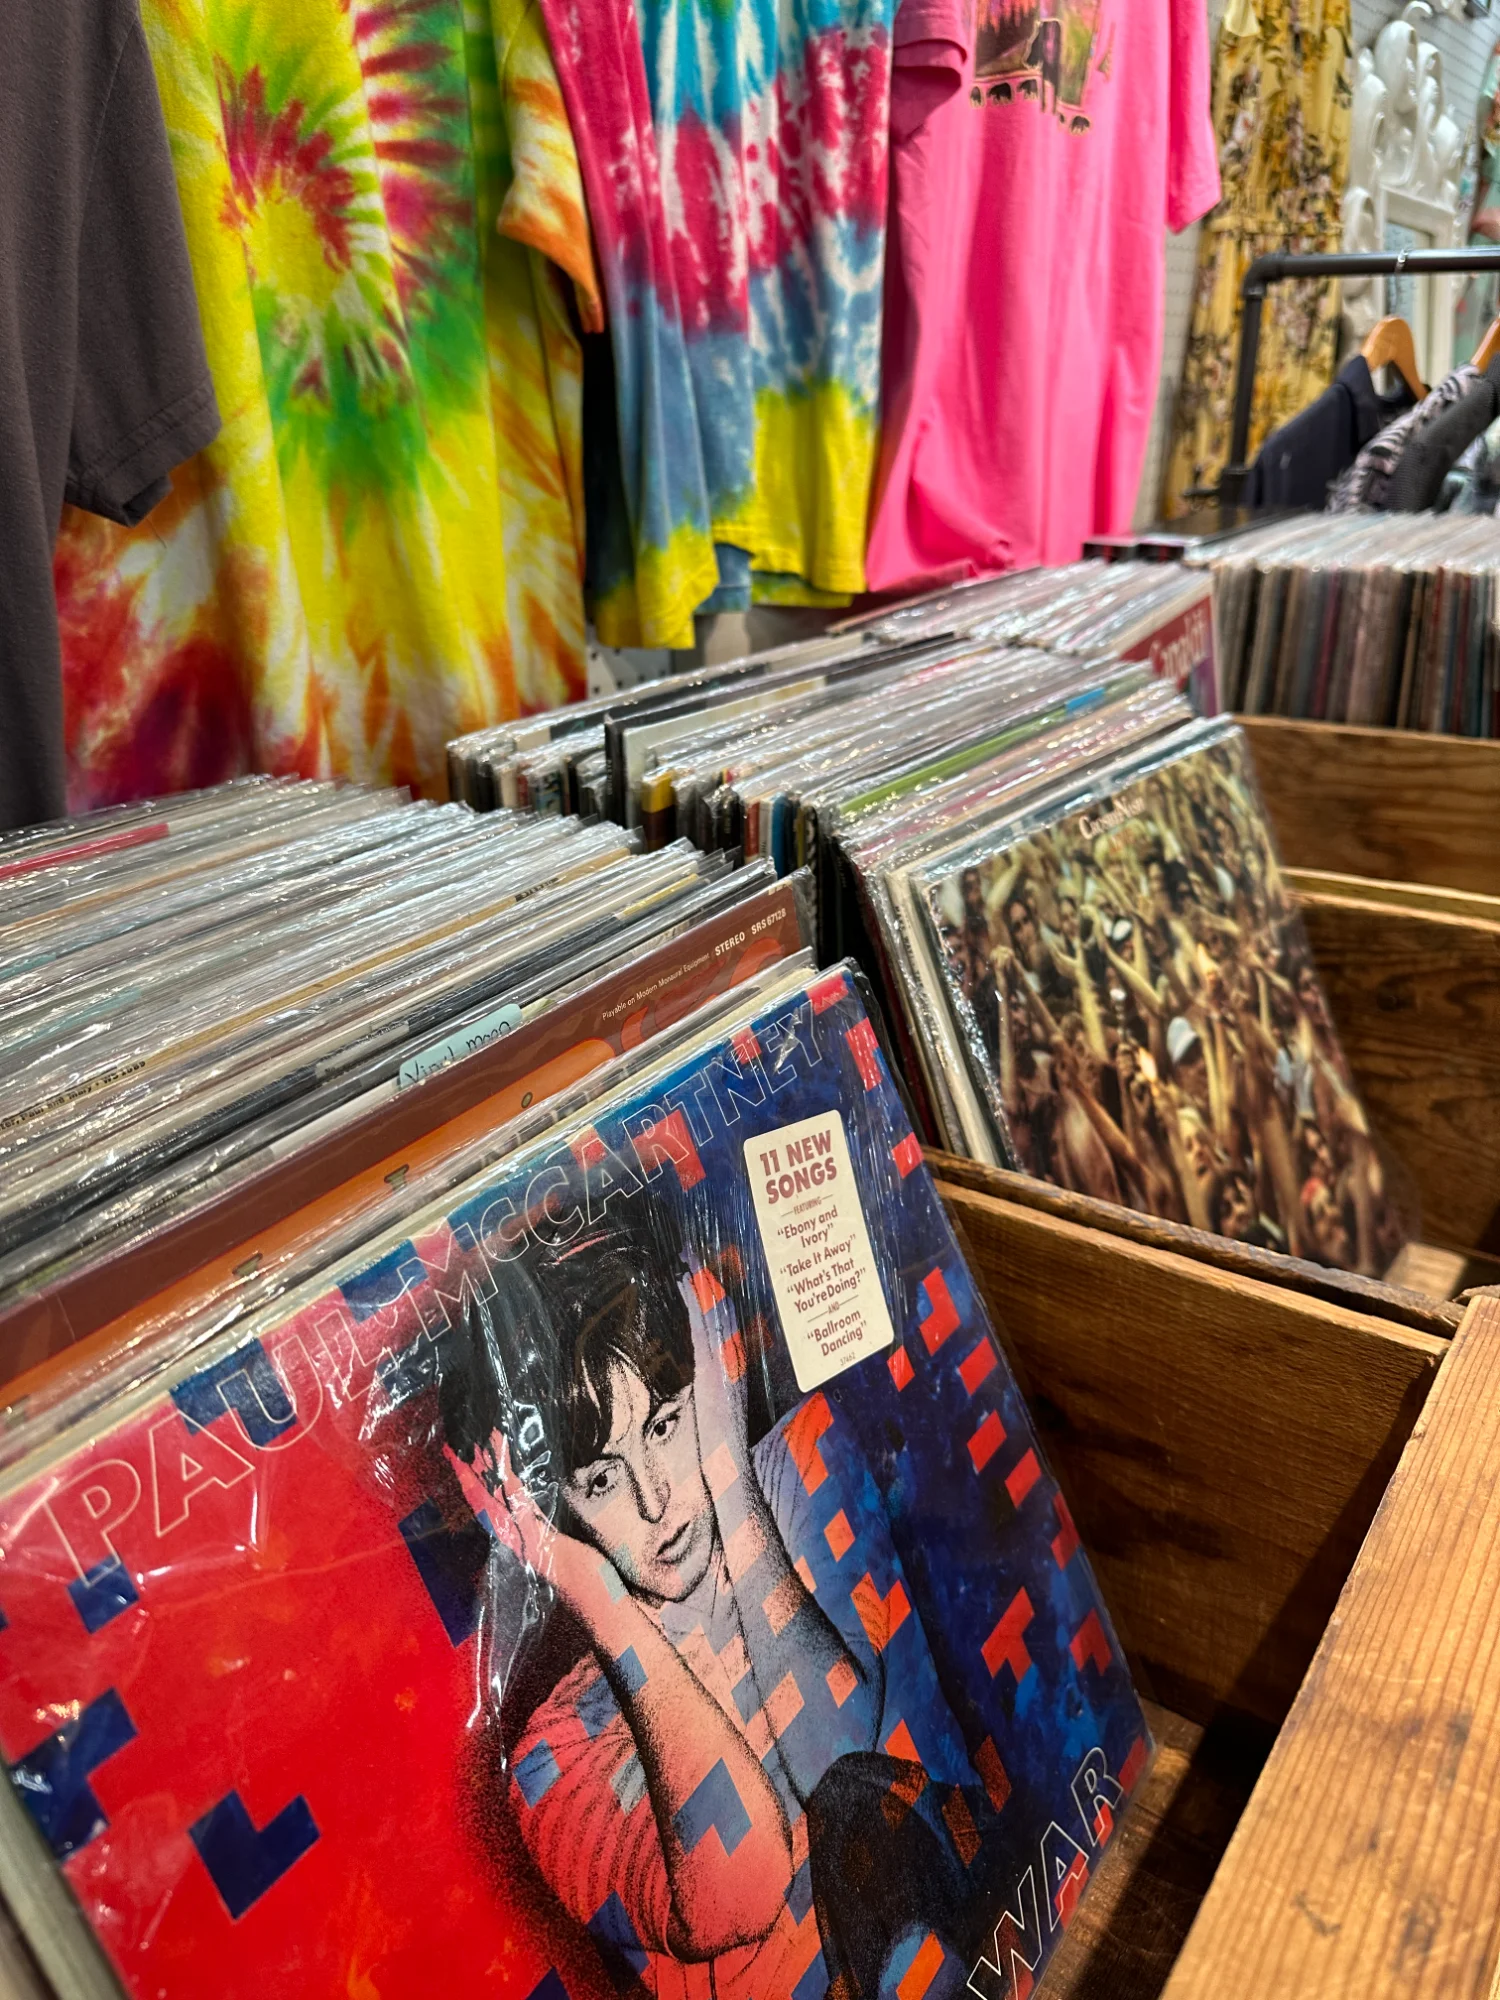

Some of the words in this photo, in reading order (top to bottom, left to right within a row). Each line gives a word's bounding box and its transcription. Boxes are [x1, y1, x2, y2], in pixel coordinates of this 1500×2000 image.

[602, 1002, 627, 1021] Playable
[627, 995, 636, 1006] on
[636, 983, 658, 1001] Modern
[658, 969, 683, 988] Monaural
[683, 953, 710, 973] Equipment
[714, 931, 746, 957] STEREO
[759, 1149, 781, 1177] 11
[785, 1130, 832, 1168] NEW
[765, 1156, 837, 1204] SONGS
[777, 1216, 817, 1239] “Ebony
[818, 1205, 838, 1223] and
[794, 1196, 822, 1214] FEATURING
[800, 1222, 833, 1248] Ivory”
[780, 1258, 812, 1277] “Take
[813, 1252, 822, 1265] It
[824, 1234, 857, 1260] Away”
[831, 1258, 855, 1276] That
[794, 1290, 827, 1313] You’re
[828, 1301, 840, 1314] AND
[807, 1310, 861, 1342] “Ballroom
[821, 1320, 867, 1356] Dancing”
[42, 1309, 399, 1588] PAUL
[966, 1746, 1124, 2000] WAR
